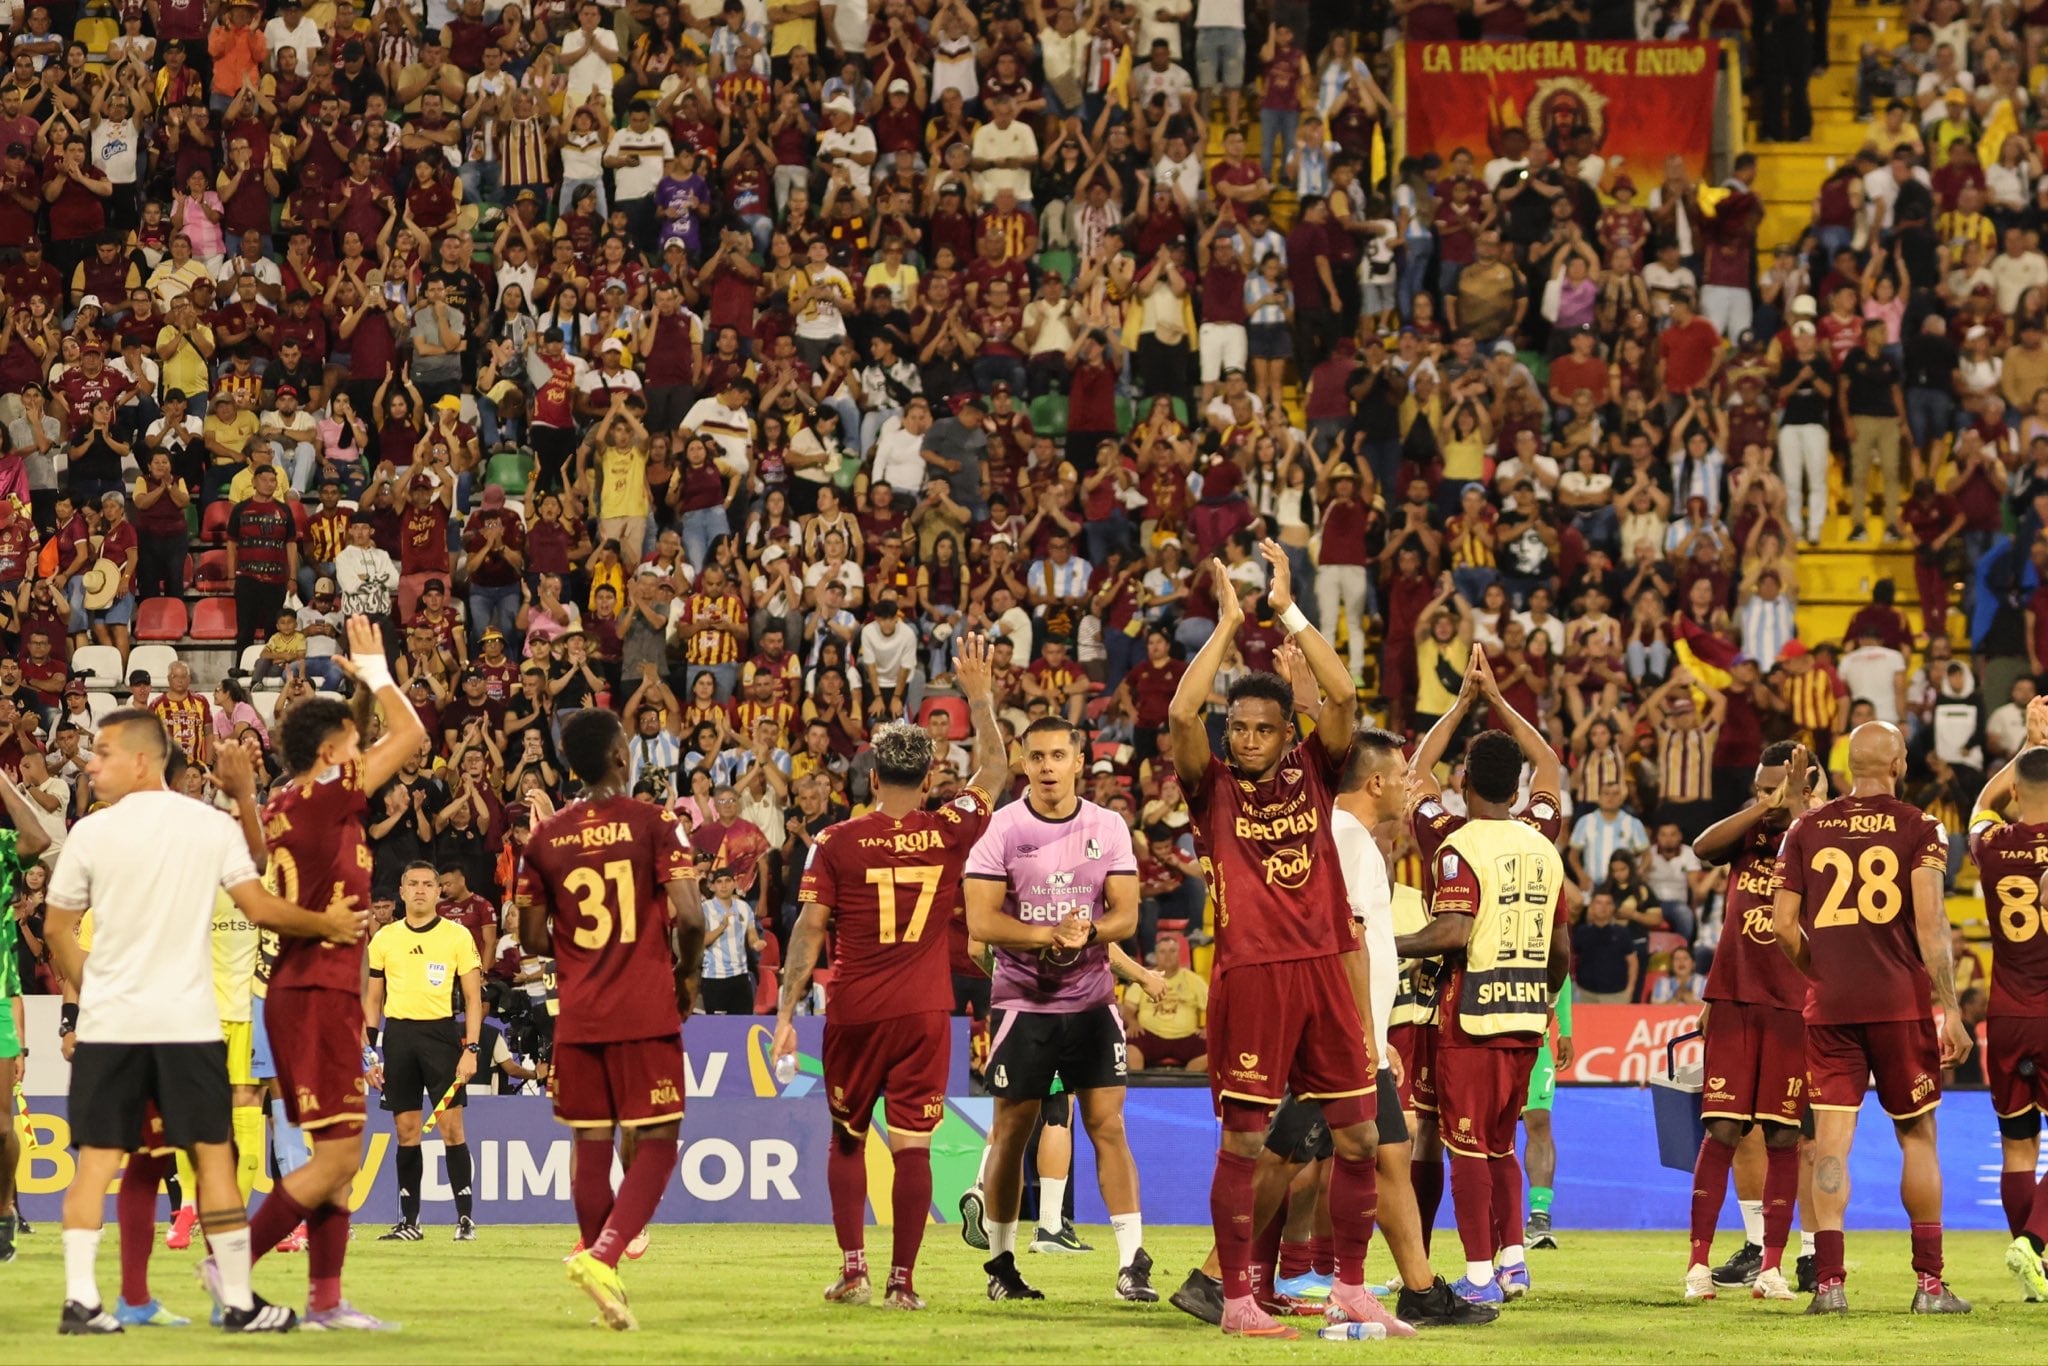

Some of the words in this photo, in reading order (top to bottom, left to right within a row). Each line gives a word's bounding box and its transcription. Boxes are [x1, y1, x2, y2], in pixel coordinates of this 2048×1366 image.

[1423, 44, 1452, 72] LA
[1460, 41, 1577, 72] HOGUERA
[1585, 45, 1628, 75] DEL
[1635, 46, 1707, 77] INDIO
[550, 834, 581, 847] TAPA
[581, 822, 633, 848] ROJA
[1235, 807, 1318, 840] BetPlay
[1817, 819, 1847, 829] TAPA
[1849, 813, 1897, 833] ROJA
[858, 838, 892, 848] TAPA
[893, 830, 945, 853] ROJA
[2000, 850, 2034, 859] TAPA
[1262, 844, 1312, 884] Pool
[1031, 883, 1093, 896] Mercacentro
[1811, 845, 1902, 929] 28
[563, 859, 637, 950] 31
[865, 865, 944, 944] 17
[1019, 899, 1096, 922] BetPla
[1995, 874, 2048, 943] 8
[428, 964, 445, 972] FIFA
[1625, 1014, 1701, 1053] Arro
[1543, 1068, 1554, 1092] 7
[1786, 1077, 1803, 1097] 18
[420, 1138, 801, 1201] DIMOR
